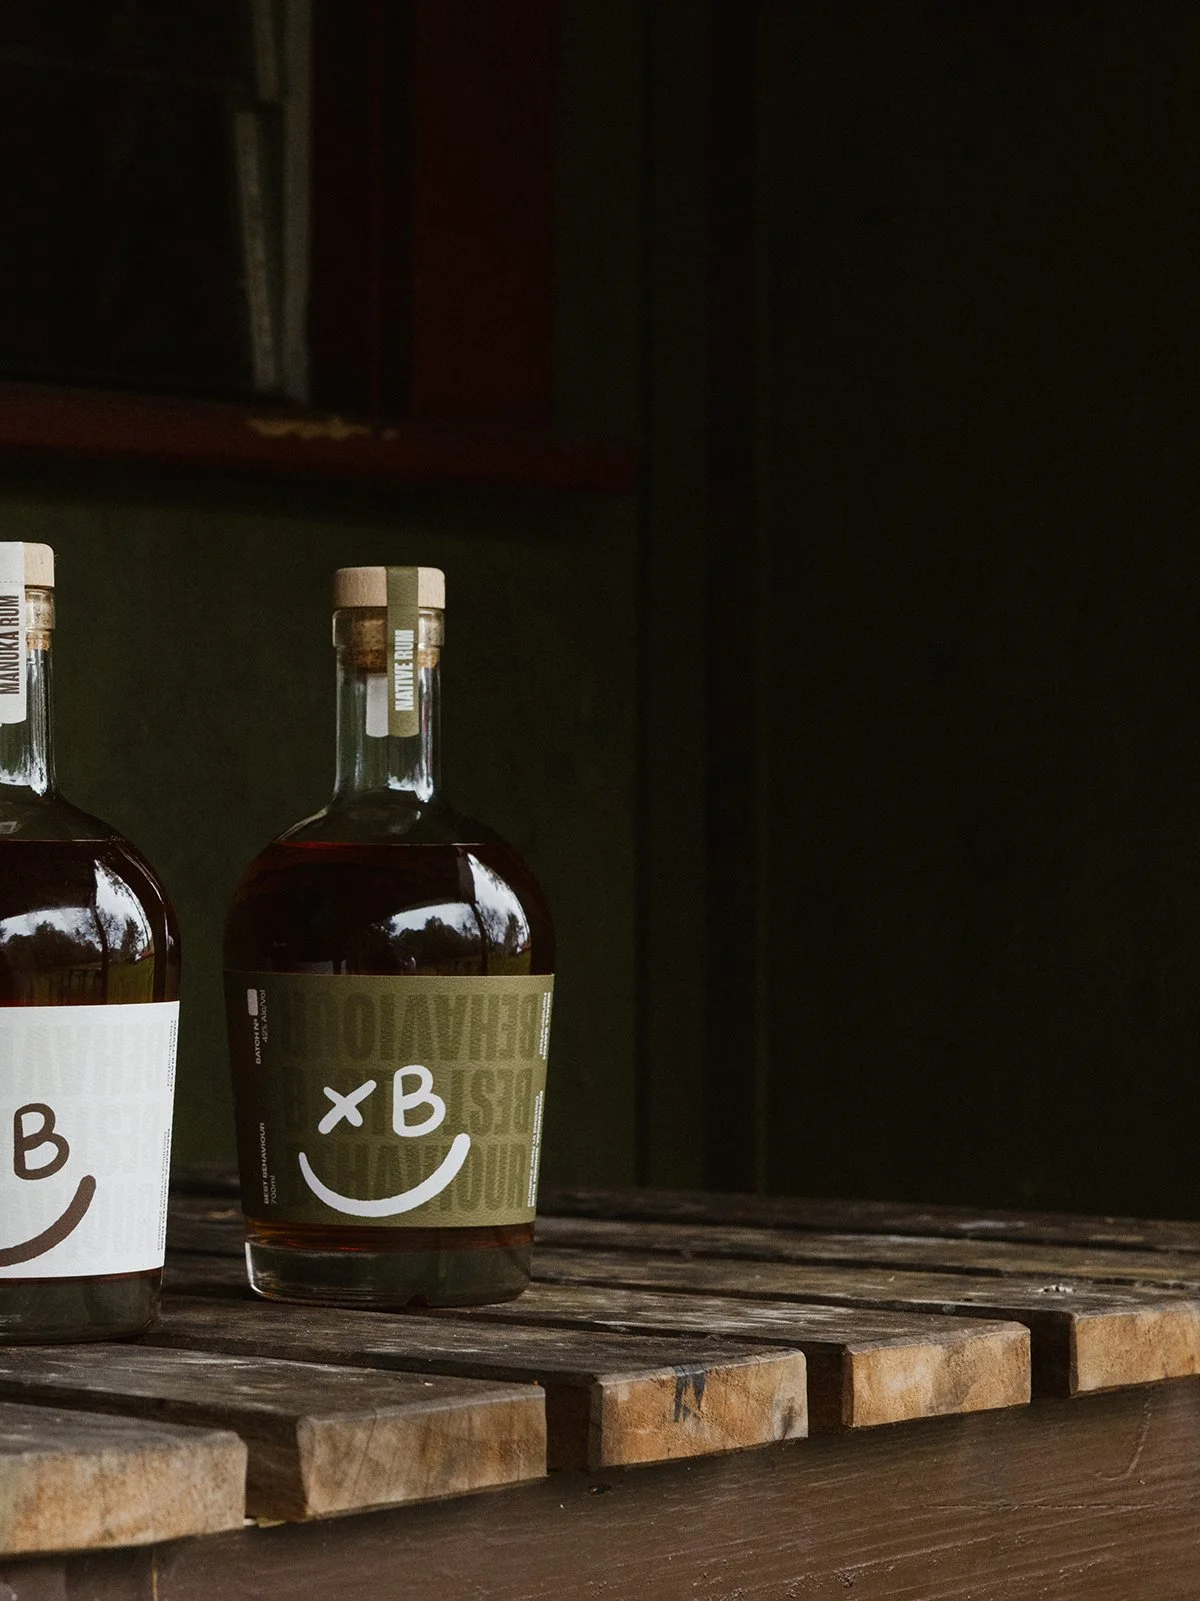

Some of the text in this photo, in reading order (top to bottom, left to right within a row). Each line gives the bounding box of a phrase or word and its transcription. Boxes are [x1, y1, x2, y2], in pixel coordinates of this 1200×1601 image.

[0, 595, 20, 628] RUM
[394, 629, 415, 712] NATIVE RUM
[254, 1032, 262, 1065] BATCH
[259, 1122, 268, 1179] BEHAVIOUR
[269, 1175, 277, 1206] 700ml
